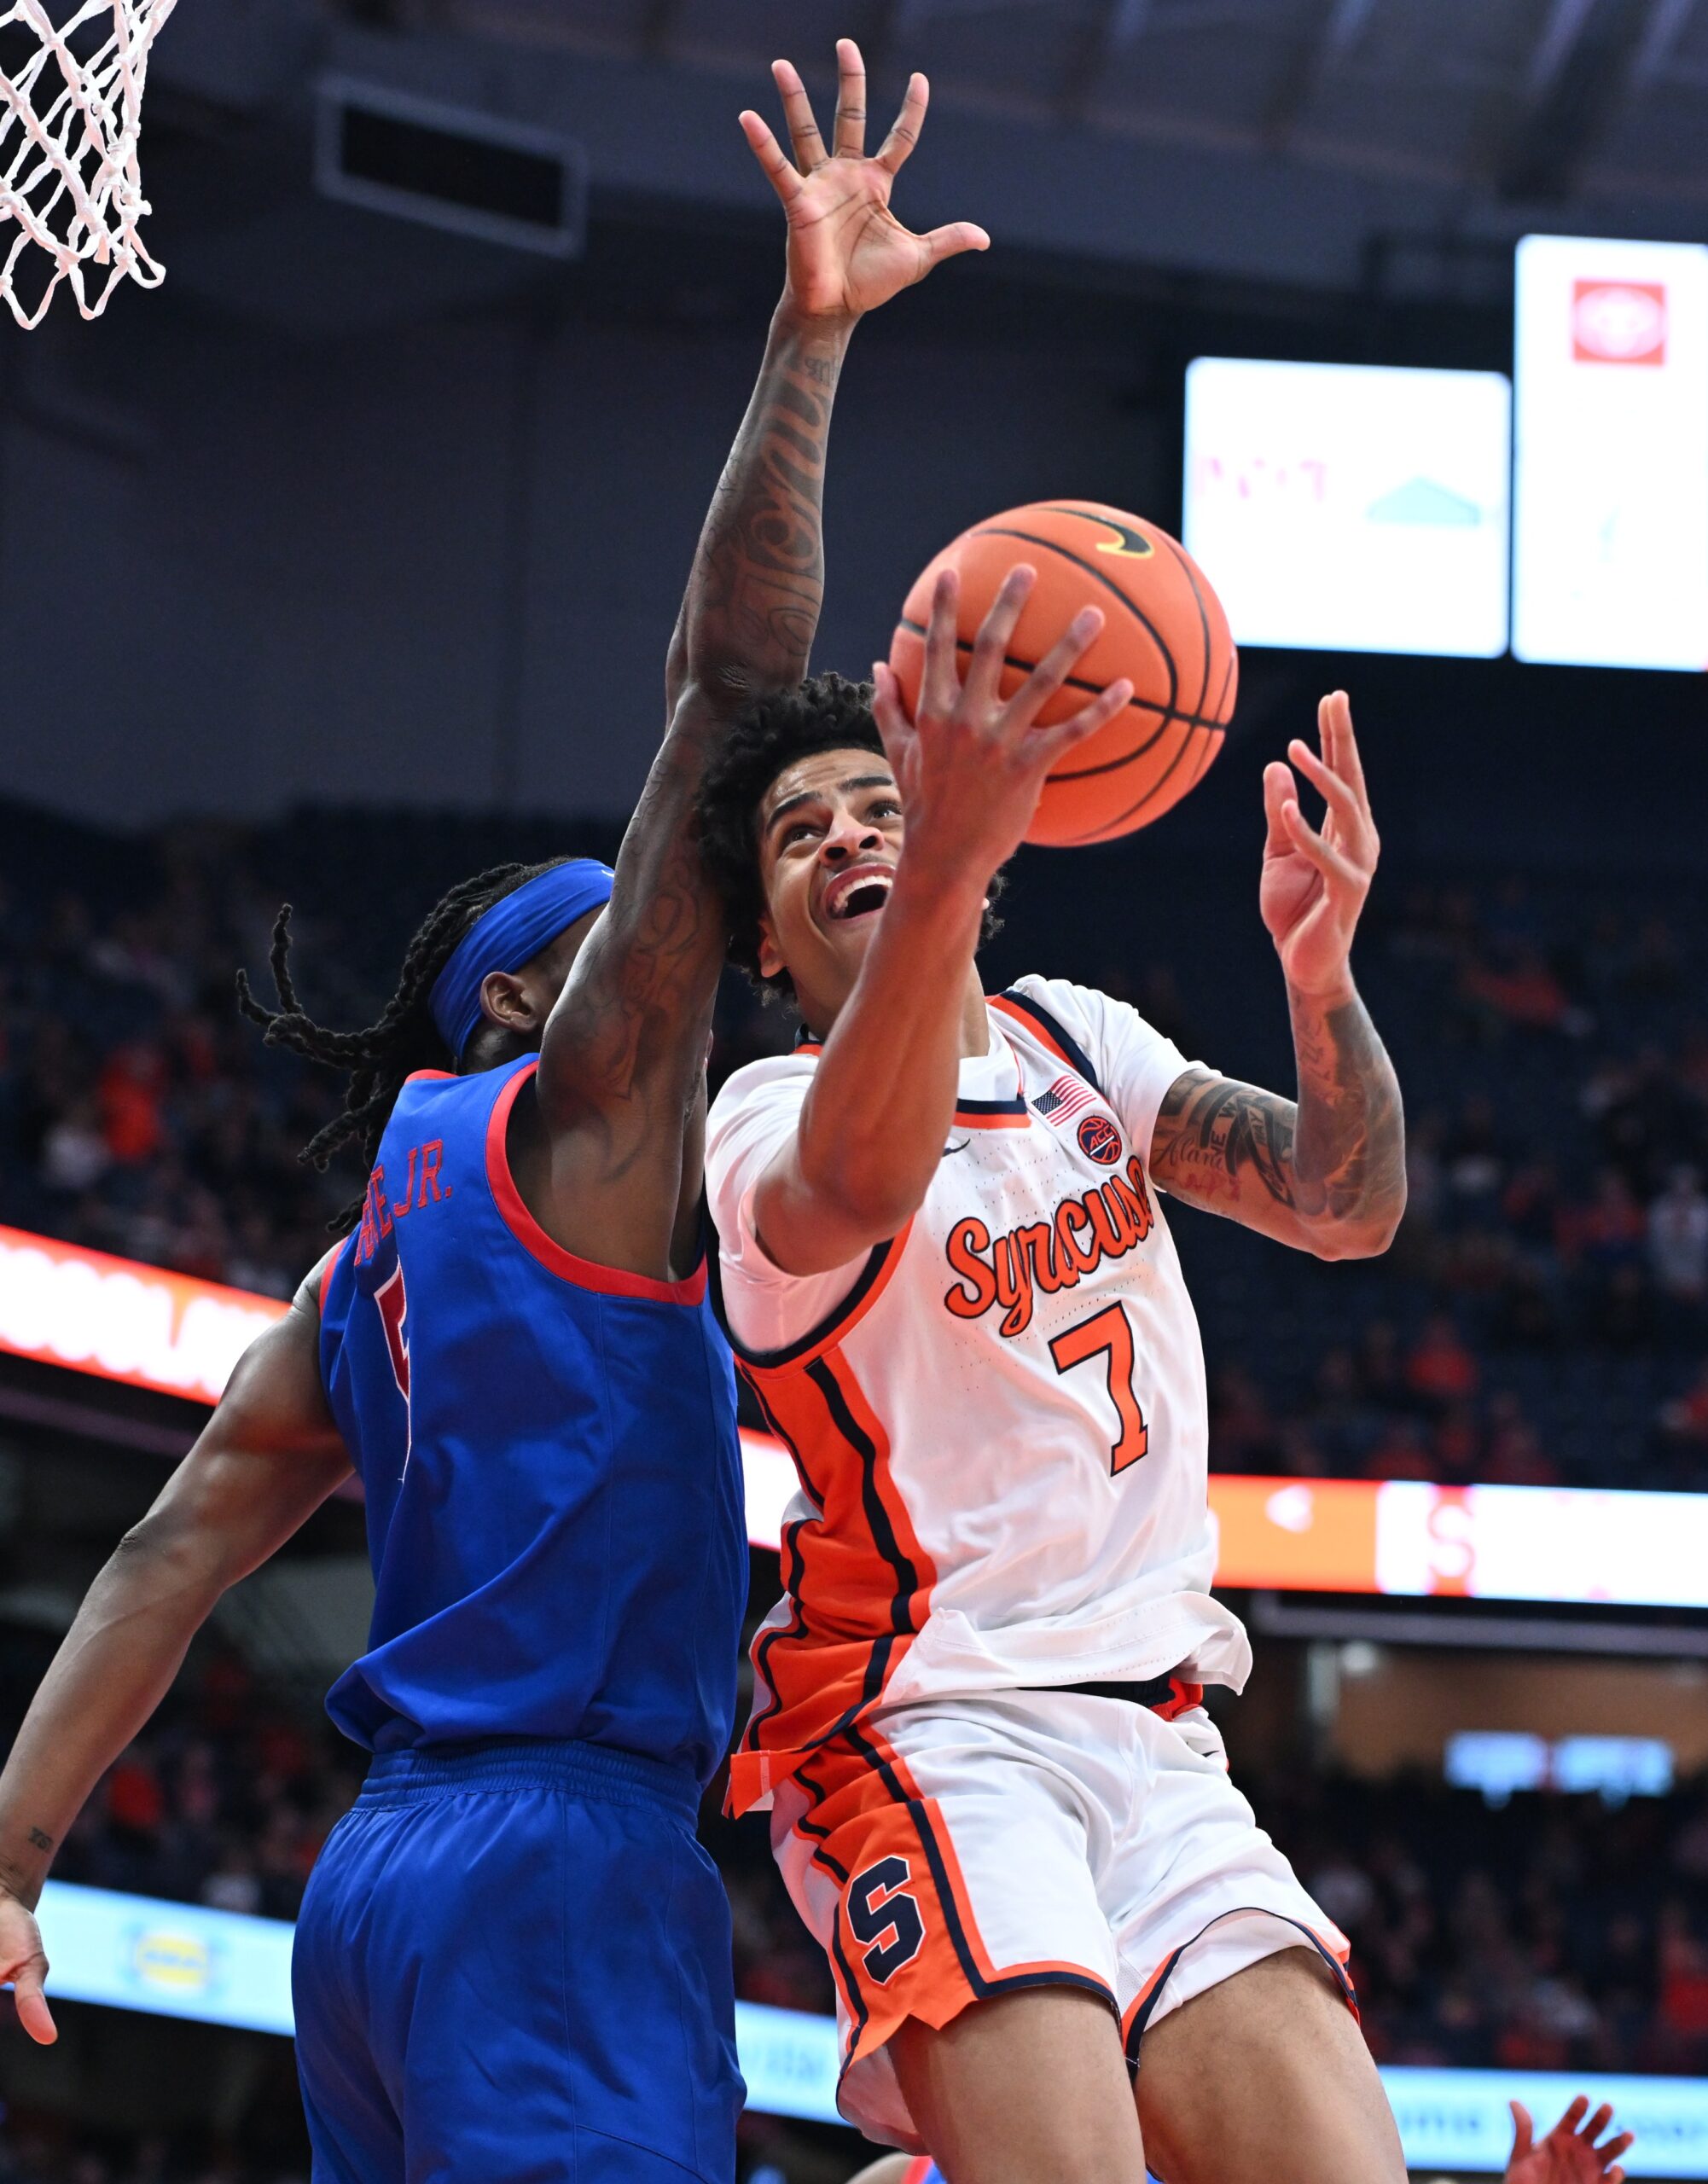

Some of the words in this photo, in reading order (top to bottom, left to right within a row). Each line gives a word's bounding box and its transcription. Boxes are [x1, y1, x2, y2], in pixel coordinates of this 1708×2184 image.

[393, 1138, 452, 1219] JR.
[1089, 1123, 1116, 1149] ACC
[1049, 1301, 1147, 1478] 7
[845, 1854, 926, 1986] S
